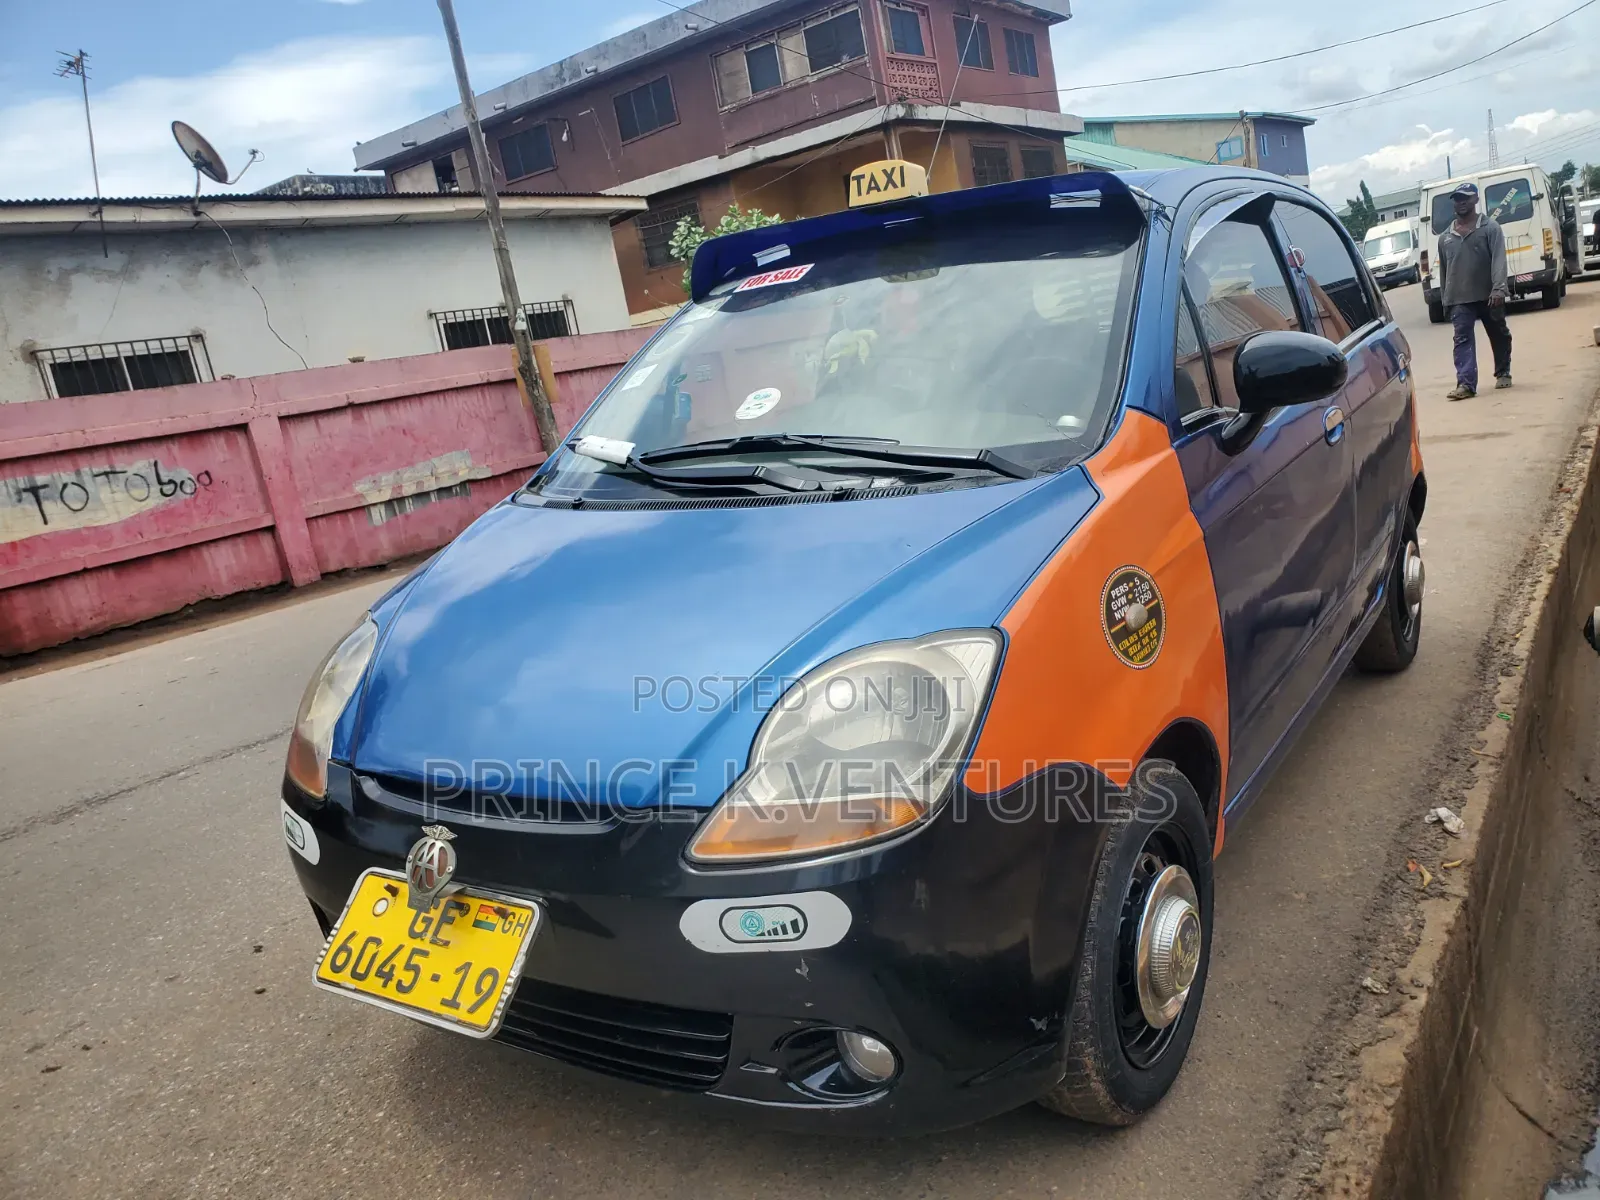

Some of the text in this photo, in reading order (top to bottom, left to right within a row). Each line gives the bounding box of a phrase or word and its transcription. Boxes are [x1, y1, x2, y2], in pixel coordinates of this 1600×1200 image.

[851, 165, 906, 197] TAXI
[740, 267, 808, 290] FOR SALE
[1110, 576, 1141, 600] PERS 5
[1110, 594, 1128, 611] GVW
[407, 899, 530, 947] GE GH
